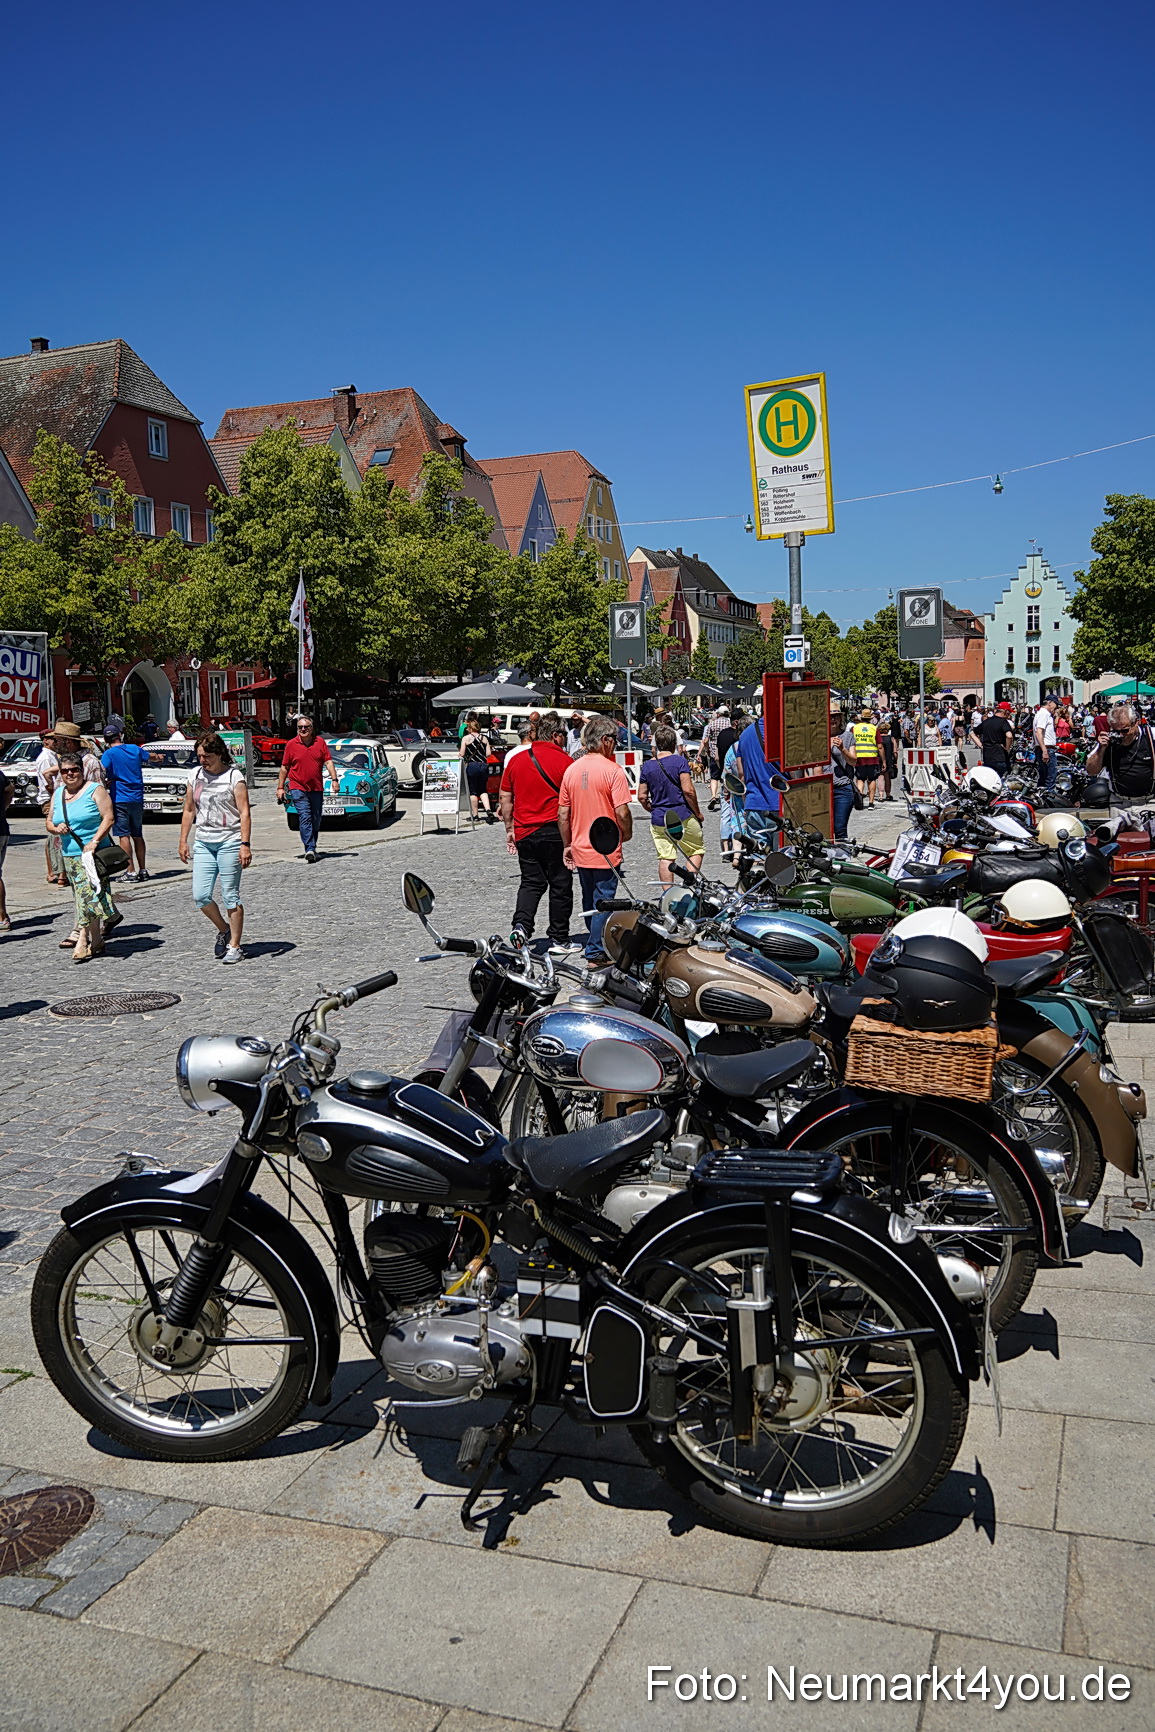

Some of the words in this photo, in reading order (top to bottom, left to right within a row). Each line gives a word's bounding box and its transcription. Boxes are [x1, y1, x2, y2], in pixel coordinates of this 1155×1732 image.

[774, 404, 799, 443] H
[771, 464, 809, 475] Rathaus
[0, 648, 38, 678] QUI
[0, 676, 38, 704] OLY
[912, 849, 930, 862] 554
